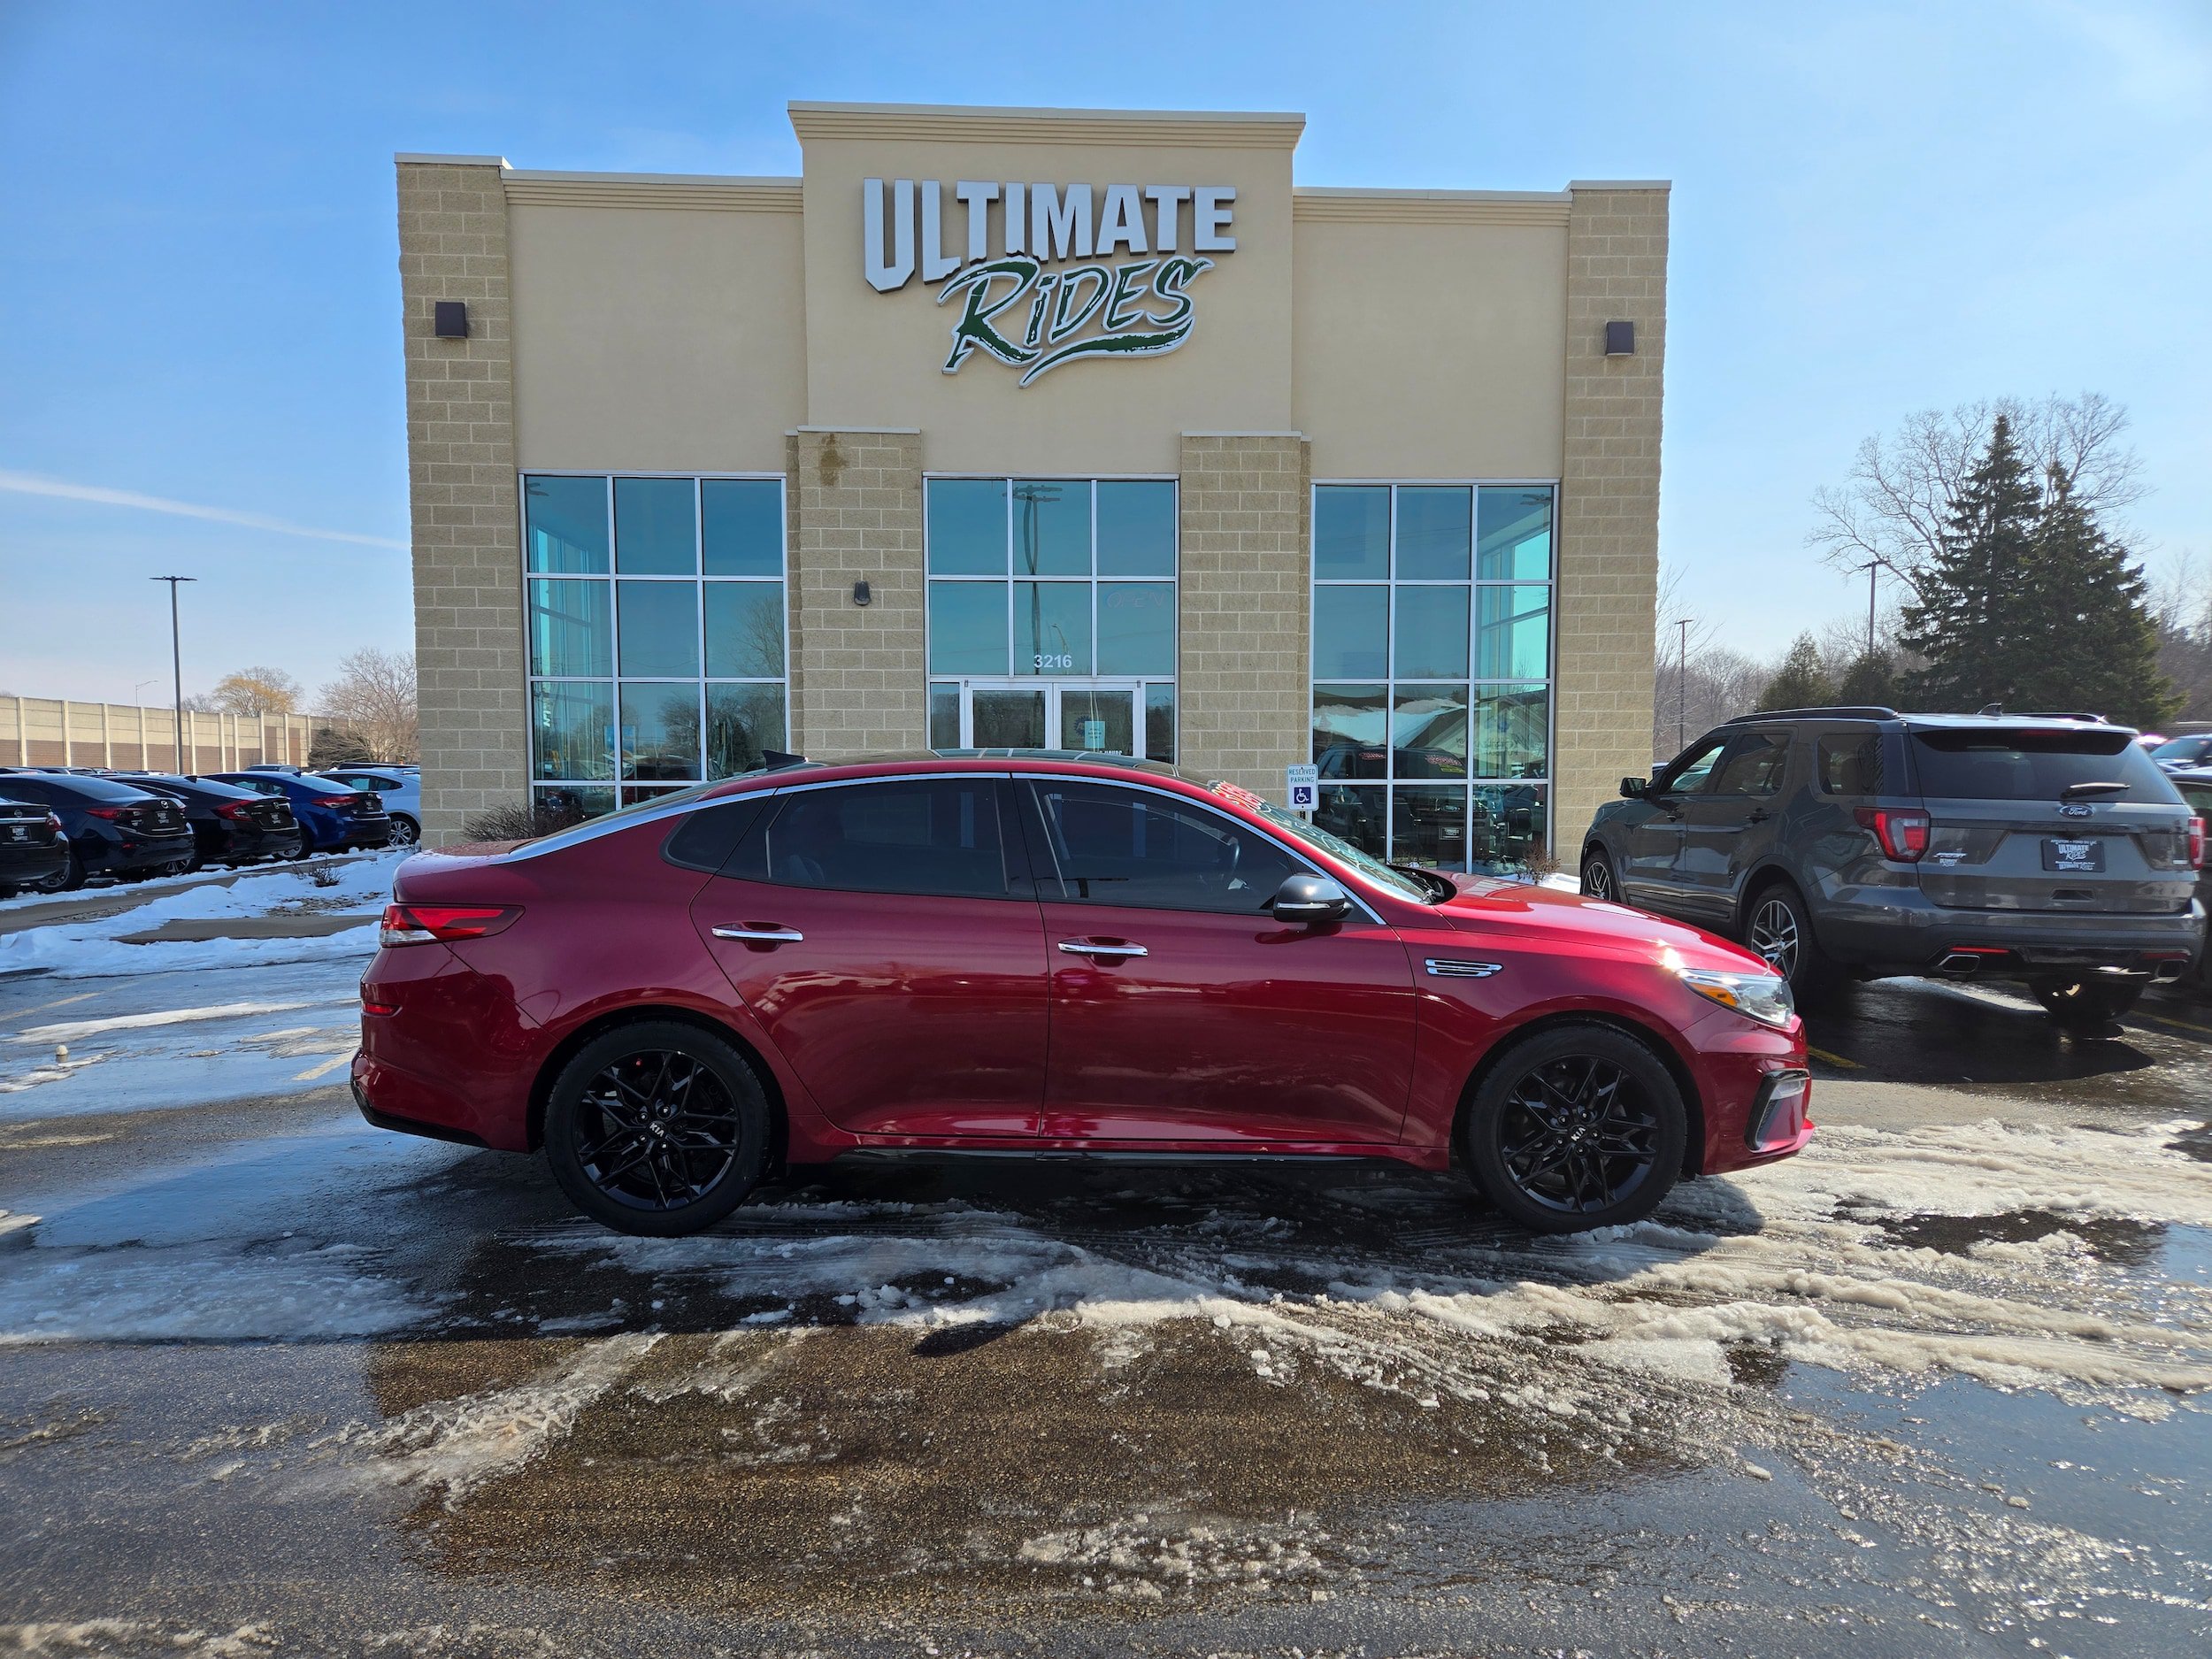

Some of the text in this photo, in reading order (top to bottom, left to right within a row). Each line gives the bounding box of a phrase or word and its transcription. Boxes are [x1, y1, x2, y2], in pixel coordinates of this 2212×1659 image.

[864, 178, 1237, 294] ULTIMATE
[1033, 654, 1072, 669] 3216
[2068, 806, 2089, 817] Ford
[2058, 844, 2089, 854] ULTIMATE
[649, 1123, 664, 1137] KIA
[1571, 1127, 1586, 1141] KIA
